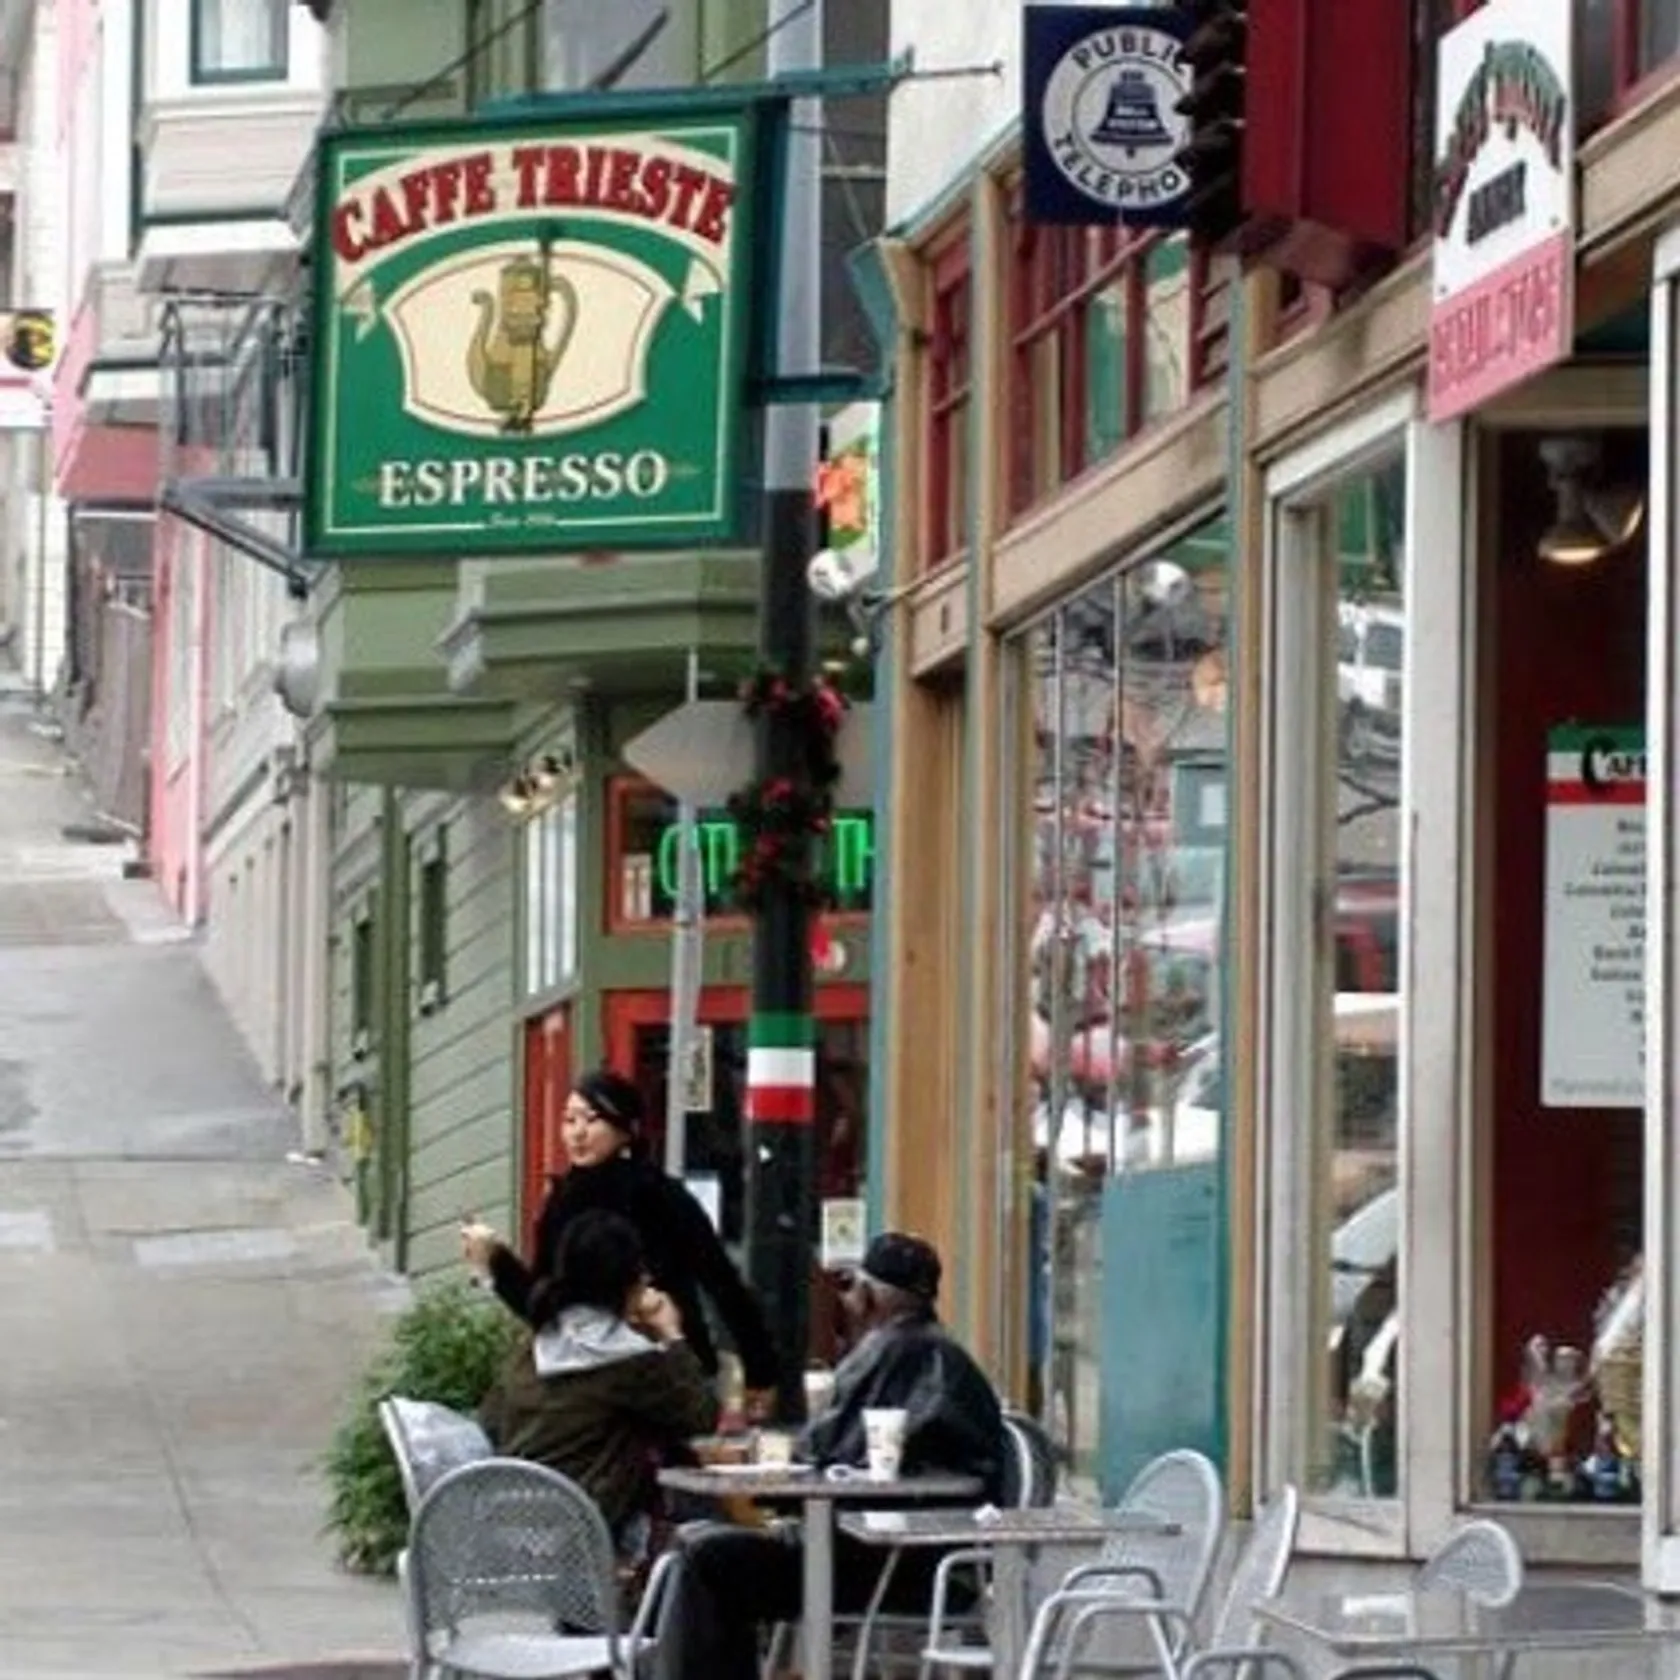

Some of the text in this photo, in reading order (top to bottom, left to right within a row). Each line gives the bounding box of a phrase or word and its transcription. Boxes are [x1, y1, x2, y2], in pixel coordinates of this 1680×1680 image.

[1055, 132, 1181, 198] TELEPHO
[331, 146, 738, 263] CAFFE TRIESTE
[378, 450, 669, 509] ESPRESSO
